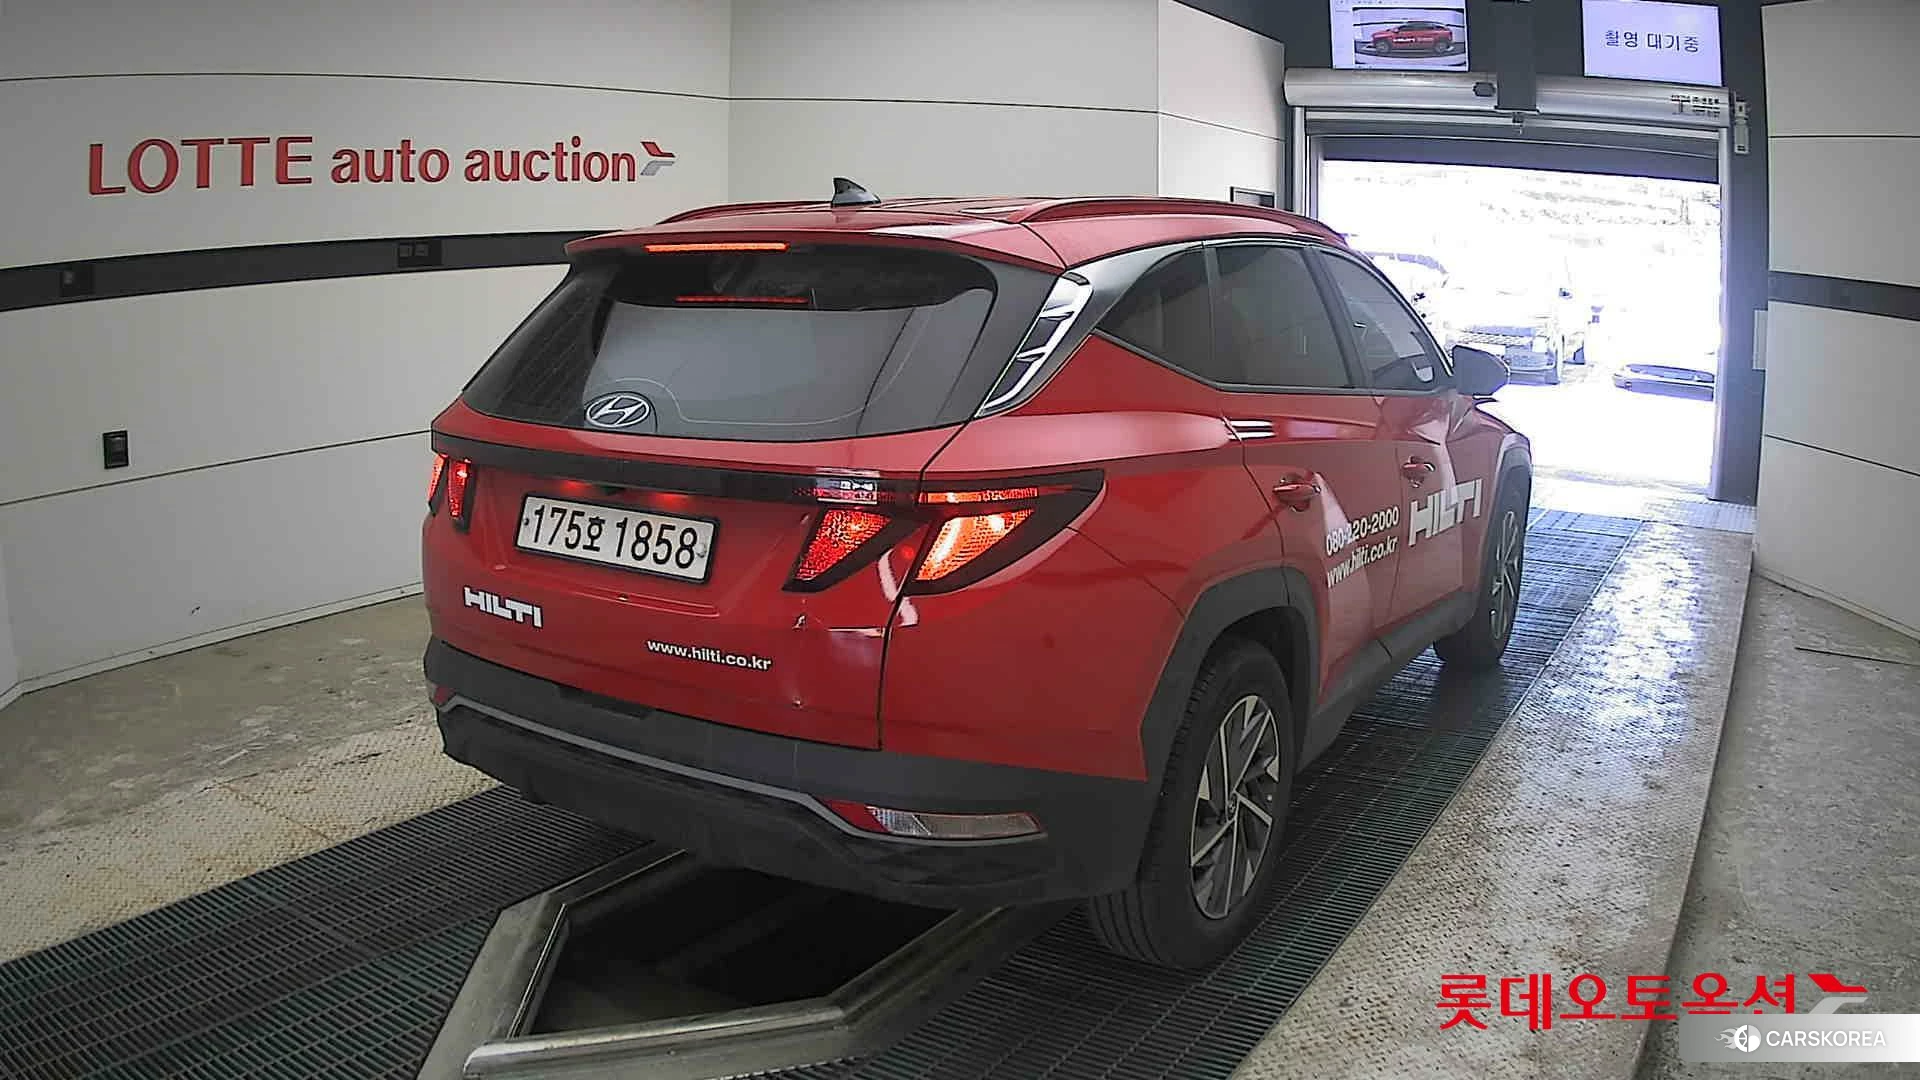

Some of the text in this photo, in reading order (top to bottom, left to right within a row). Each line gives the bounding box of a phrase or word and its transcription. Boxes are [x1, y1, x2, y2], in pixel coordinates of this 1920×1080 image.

[1605, 30, 1638, 48] 촬영
[88, 136, 636, 196] LOTTE auto auction
[532, 504, 698, 569] 175호 1858
[1326, 506, 1400, 557] 080-220-2000
[1408, 478, 1483, 547] HILTI
[1326, 535, 1399, 590] www.hilti.co.kr
[463, 586, 543, 629] HILTI
[646, 639, 772, 671] www.hilti.co.kr
